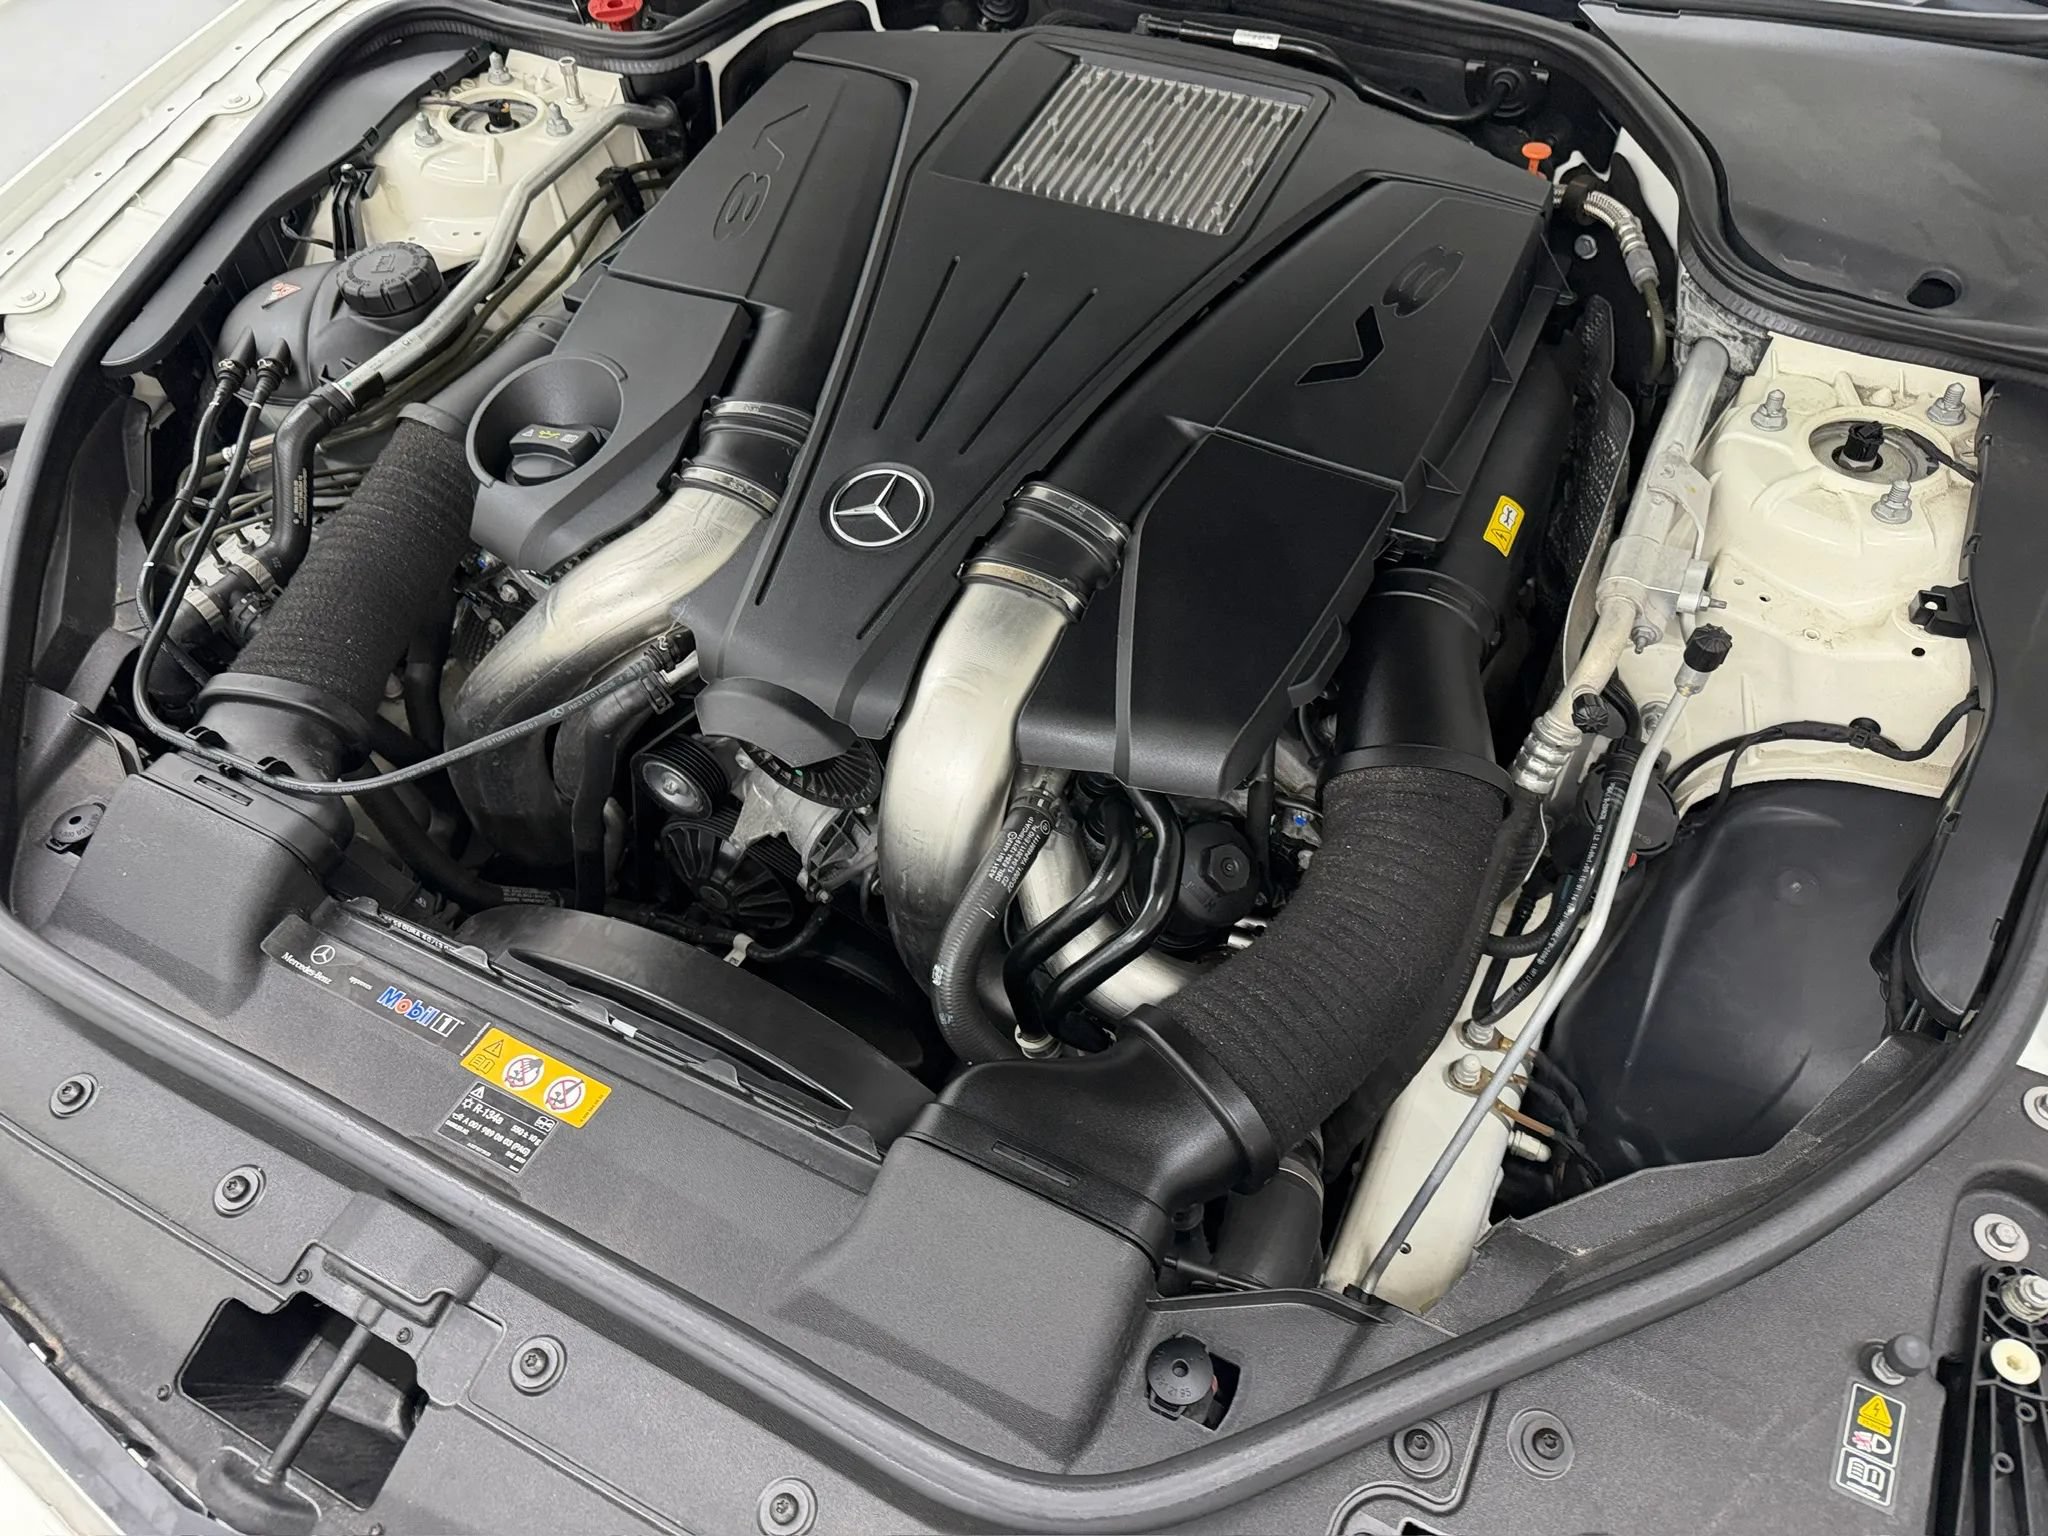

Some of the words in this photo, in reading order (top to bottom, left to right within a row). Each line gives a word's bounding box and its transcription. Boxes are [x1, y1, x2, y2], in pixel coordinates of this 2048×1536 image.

[1295, 245, 1464, 386] V8
[281, 952, 333, 985] Mercedes-Benz
[377, 986, 440, 1027] Mobil
[472, 1103, 504, 1125] R-134a
[468, 1120, 482, 1131] 001
[510, 1143, 531, 1157] (PAG)
